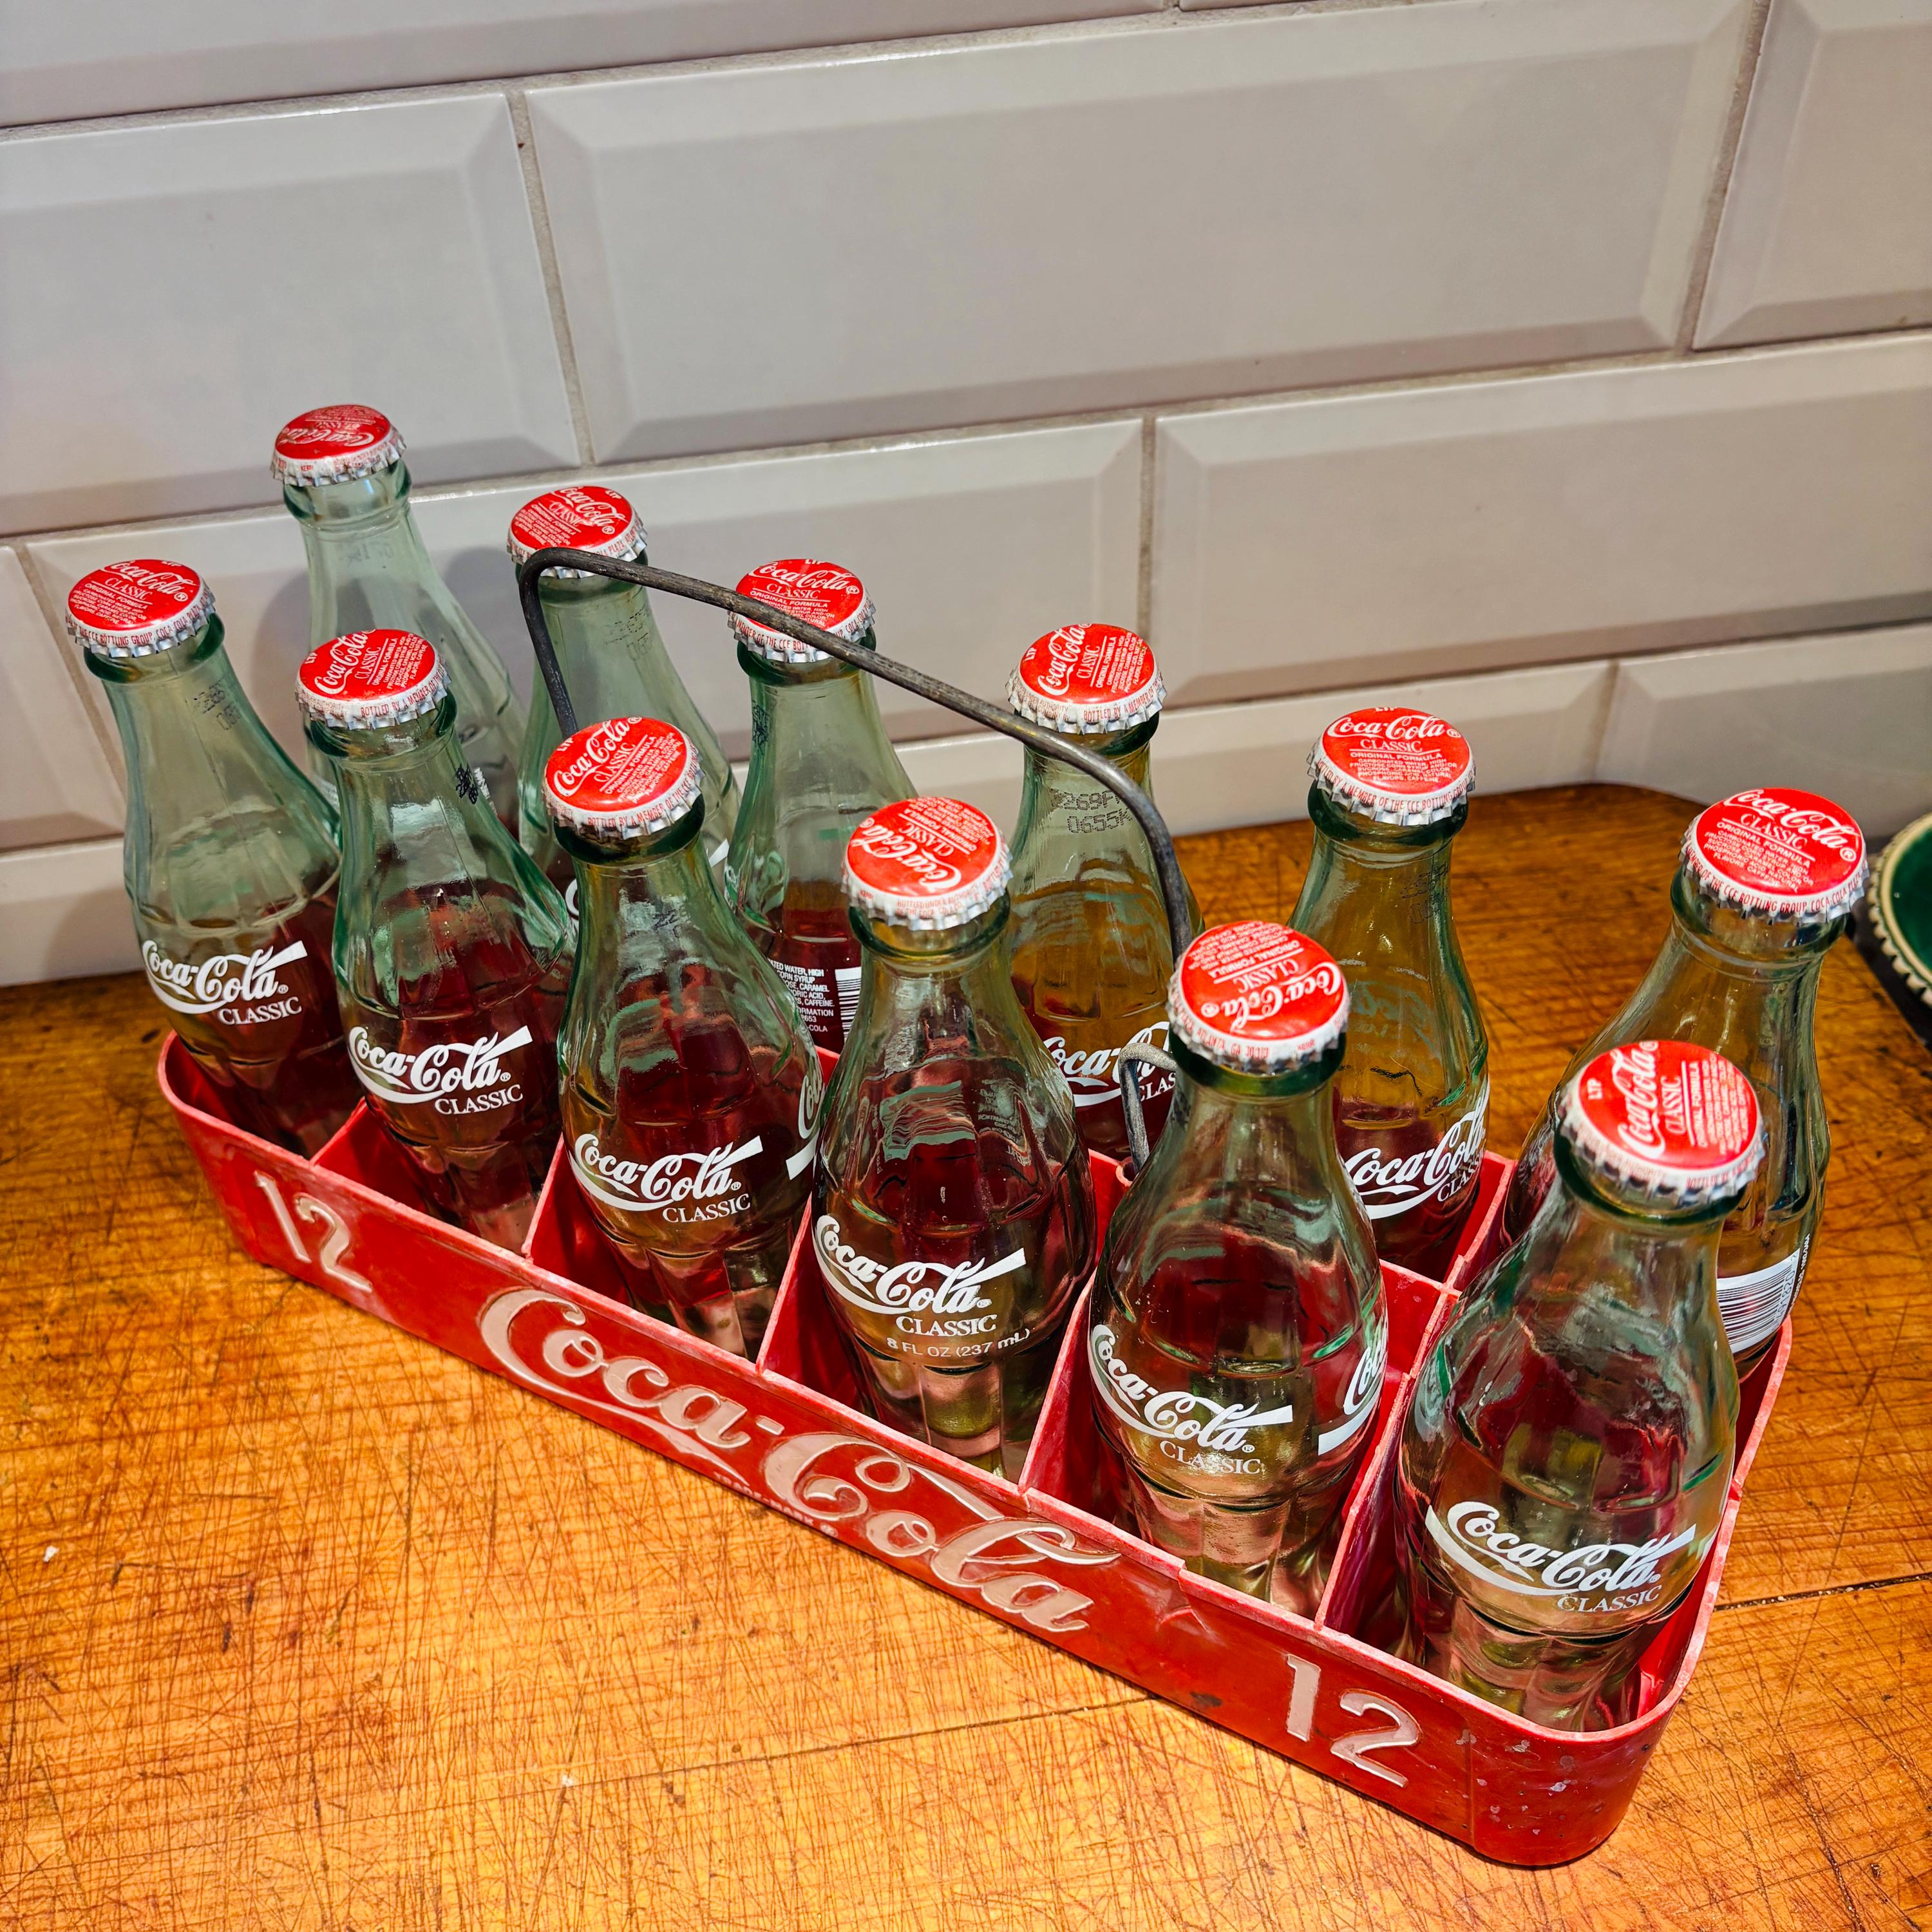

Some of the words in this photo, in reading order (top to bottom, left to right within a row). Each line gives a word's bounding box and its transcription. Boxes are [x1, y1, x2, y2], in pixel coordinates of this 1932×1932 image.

[549, 502, 583, 527] CLASSIC
[551, 488, 629, 527] Coca-Cola
[553, 519, 576, 536] FORMULA
[99, 561, 197, 594] Coca-Cola
[104, 578, 153, 600] CLASSIC
[748, 562, 857, 591] Coca-Cola
[766, 583, 820, 599] CLASSIC
[84, 583, 116, 599] ORIGINAL
[118, 596, 149, 611] FORMULA
[750, 591, 788, 605] ORIGINAL
[100, 634, 129, 645] BOTTLING
[383, 638, 398, 666] FORMULA
[756, 632, 764, 643] OF
[766, 635, 777, 647] THE
[779, 639, 790, 650] CCE
[1024, 647, 1037, 661] LTP
[314, 634, 368, 695] Coca-Cola
[354, 647, 382, 679] CLASSIC
[1037, 627, 1086, 696] Coca-Cola
[1076, 645, 1100, 679] CLASSIC
[1095, 664, 1109, 688] ORIGINAL
[1103, 637, 1117, 663] FORMULA
[361, 704, 390, 717] BOTTLED
[392, 701, 400, 712] BY
[1084, 708, 1111, 722] BOTTLED
[1113, 706, 1121, 719] BY
[1128, 692, 1150, 714] MEMBER
[1327, 715, 1445, 740] Coca-Cola
[554, 720, 630, 797] Coca-Cola
[557, 737, 574, 752] LTP
[1350, 752, 1396, 761] ORIGINAL
[1360, 740, 1423, 752] CLASSIC
[594, 743, 636, 782] CLASSIC
[605, 766, 634, 794] ORIGINAL
[629, 737, 657, 766] FORMULA
[1332, 775, 1342, 786] BY
[1341, 782, 1348, 791] A
[1347, 783, 1377, 805] MEMBER
[1379, 796, 1389, 808] OF
[1390, 799, 1405, 811] THE
[1408, 800, 1419, 811] CCE
[1422, 791, 1454, 809] BOTTLING
[587, 817, 616, 828] BOTTLED
[620, 817, 628, 826] BY
[631, 816, 637, 826] A
[637, 804, 664, 822] MEMBER
[665, 797, 675, 808] OF
[904, 808, 942, 830] FORMULA
[1723, 790, 1861, 848] Coca-Cola
[898, 823, 955, 857] CLASSIC
[942, 827, 978, 852] ORIGINAL
[1704, 831, 1740, 848] FRUCTOSE
[1741, 846, 1762, 858] CORN
[1717, 822, 1761, 844] ORIGINAL
[1763, 840, 1810, 869] FORMULA
[1718, 830, 1765, 852] CARBONATED
[1740, 813, 1808, 849] CLASSIC
[849, 825, 961, 893] Coca-Cola
[1703, 843, 1750, 864] PHOSPHORIC
[1768, 870, 1799, 893] NATURAL
[1700, 867, 1712, 881] OF
[1710, 875, 1725, 893] THE
[1723, 884, 1739, 900] CCE
[1739, 894, 1777, 913] BOTTLING
[1251, 940, 1300, 961] ORIGINAL
[142, 940, 287, 1006] Coca-Cola
[794, 976, 815, 984] SYRUP
[808, 969, 824, 977] HIGH
[1208, 958, 1256, 979] FORMULA
[1233, 959, 1299, 994] CLASSIC
[799, 983, 829, 992] CARAMEL
[1221, 962, 1341, 1031] Coca-Cola
[218, 996, 302, 1025] CLASSIC
[348, 1026, 515, 1097] Coca-Cola
[1231, 1043, 1242, 1055] GA
[435, 1084, 524, 1115] CLASSIC
[1586, 1077, 1604, 1100] LTP
[1689, 1063, 1703, 1108] FORMULA
[1610, 1049, 1666, 1159] Coca-Cola
[1660, 1075, 1687, 1135] CLASSIC
[1345, 1095, 1486, 1186] Coca-Cola
[572, 1133, 741, 1206] Coca-Cola
[662, 1193, 751, 1224] CLASSIC
[815, 1215, 989, 1315] Coca-Cola
[896, 1314, 998, 1337] CLASSIC
[887, 1338, 899, 1350] 8
[902, 1343, 923, 1356] FL
[927, 1347, 951, 1358] OZ
[955, 1343, 990, 1358] (237
[998, 1328, 1030, 1350] mL)
[1088, 1324, 1253, 1454] Coca-Cola
[1159, 1440, 1262, 1475] CLASSIC
[1443, 1501, 1668, 1593] Coca-Cola
